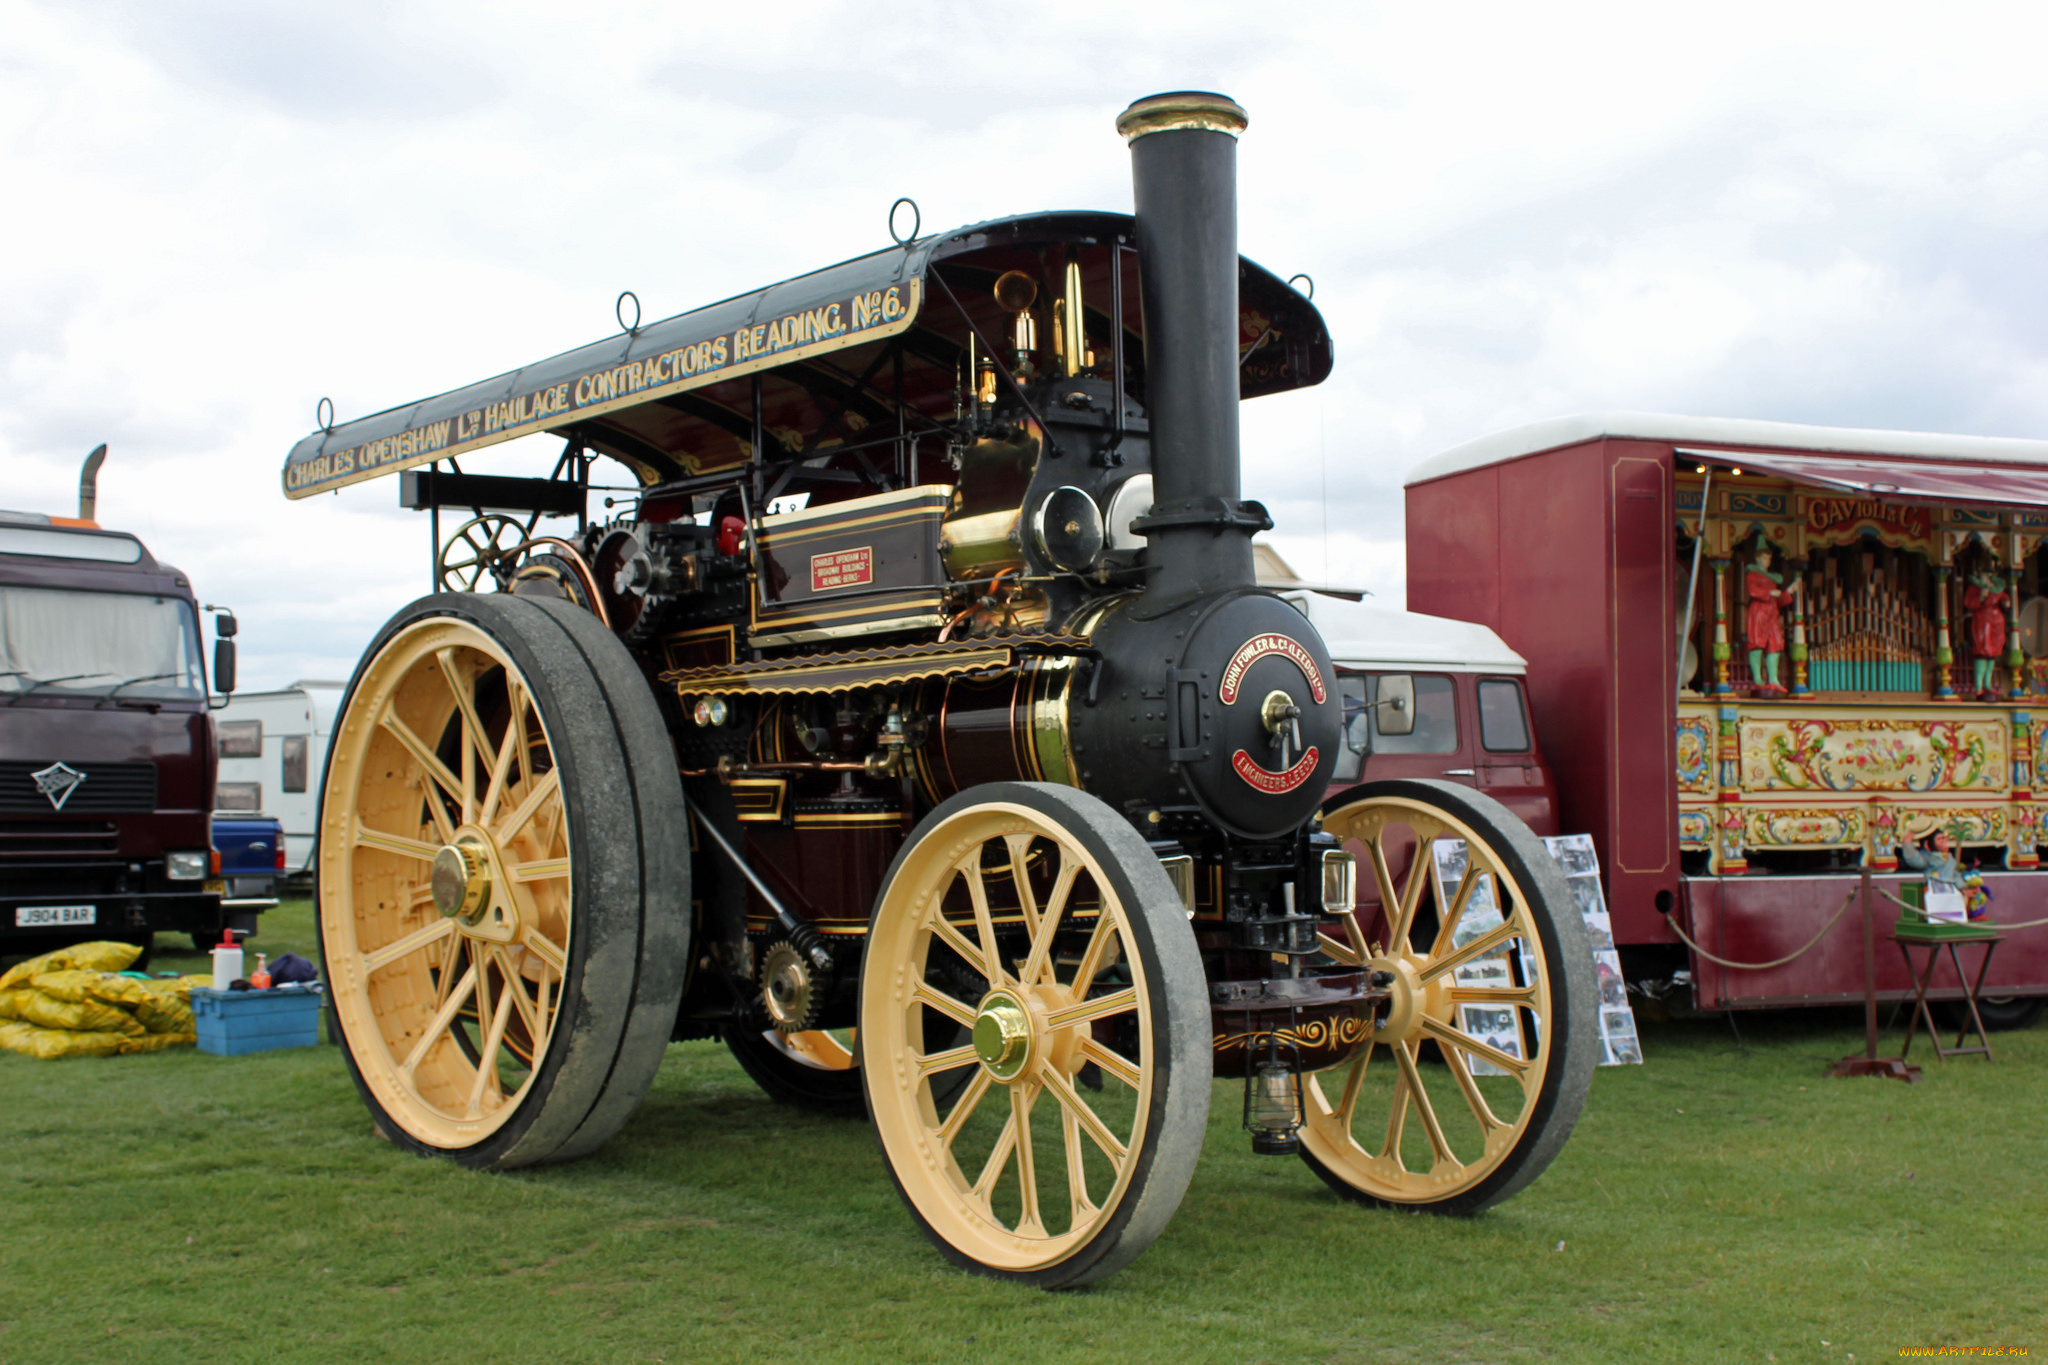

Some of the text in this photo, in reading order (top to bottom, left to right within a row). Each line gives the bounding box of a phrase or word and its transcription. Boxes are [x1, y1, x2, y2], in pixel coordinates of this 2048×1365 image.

[286, 449, 354, 490] CHARLES
[359, 420, 450, 472] OPENSHAW
[484, 383, 569, 434] HAULAGE
[575, 335, 727, 408] CONTRACTORS
[1225, 663, 1241, 696] JOHN
[1236, 637, 1269, 668] FOWLER
[1268, 637, 1278, 650] &
[1288, 754, 1314, 785] LEEDS
[23, 909, 89, 923] J904 BAR
